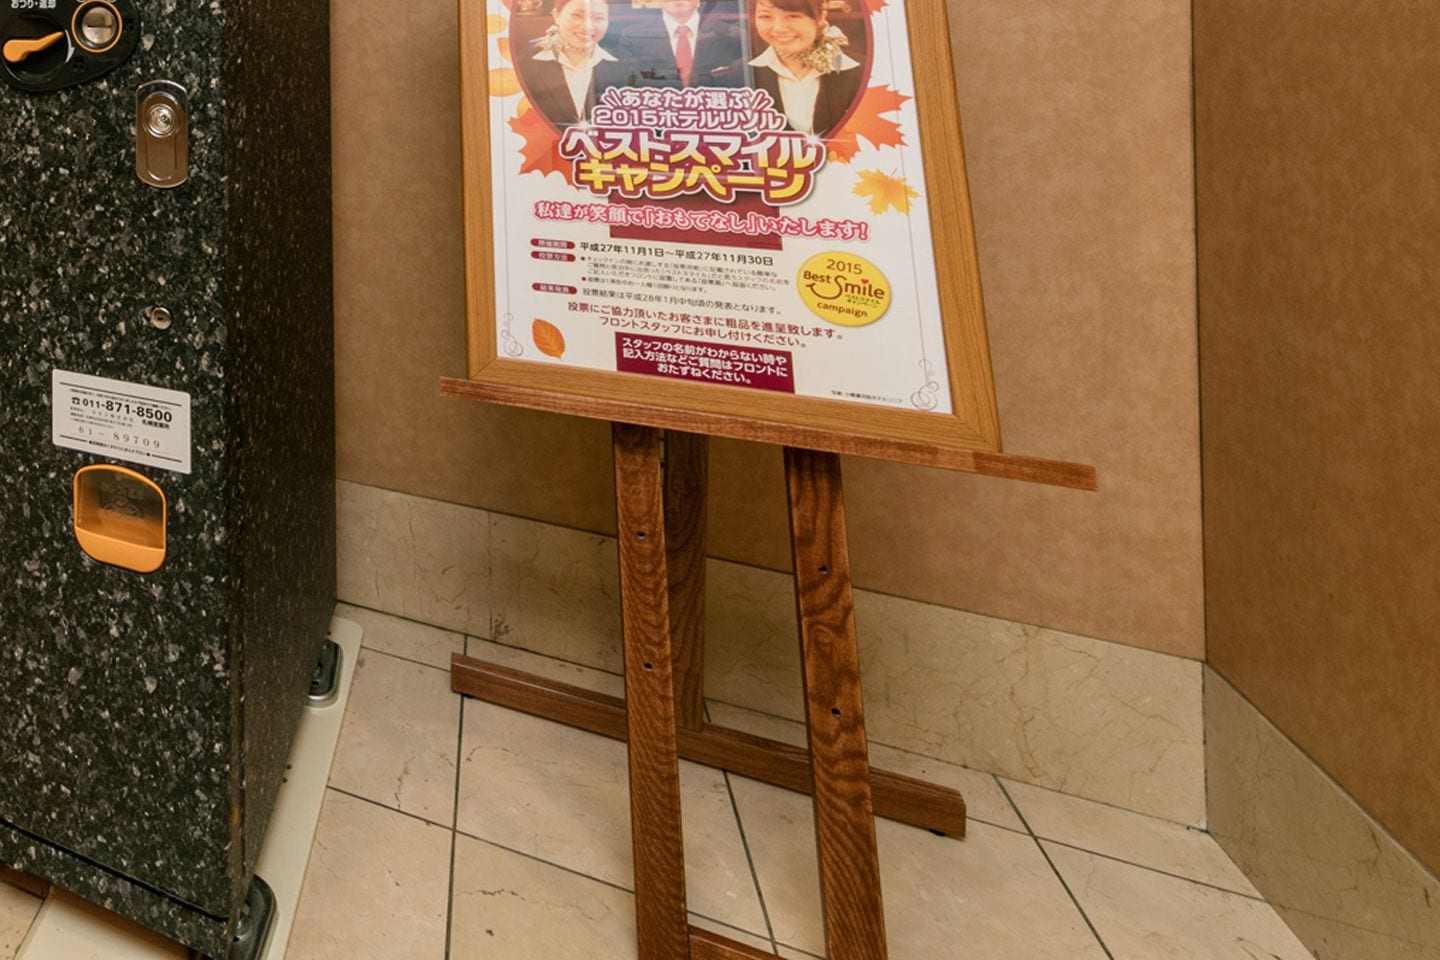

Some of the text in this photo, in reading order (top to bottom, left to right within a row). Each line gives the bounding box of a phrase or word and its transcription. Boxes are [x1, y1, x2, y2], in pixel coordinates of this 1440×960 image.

[623, 90, 750, 110] あなたが選ぶ
[595, 108, 782, 131] 2015ホテルリソル
[565, 129, 818, 169] ベストスマイル
[578, 158, 805, 199] キャンペーン
[827, 259, 863, 275] 2015
[803, 270, 885, 300] Best Smile
[816, 300, 868, 317] campaign
[599, 316, 807, 348] フロントスタッフにお申し付けください。
[622, 337, 787, 365] スタッフの名前がわからない時や
[622, 347, 788, 377] 記入方法などご質問はフロントに
[657, 363, 752, 385] おたずねください。
[82, 398, 173, 422] 011-871-8500
